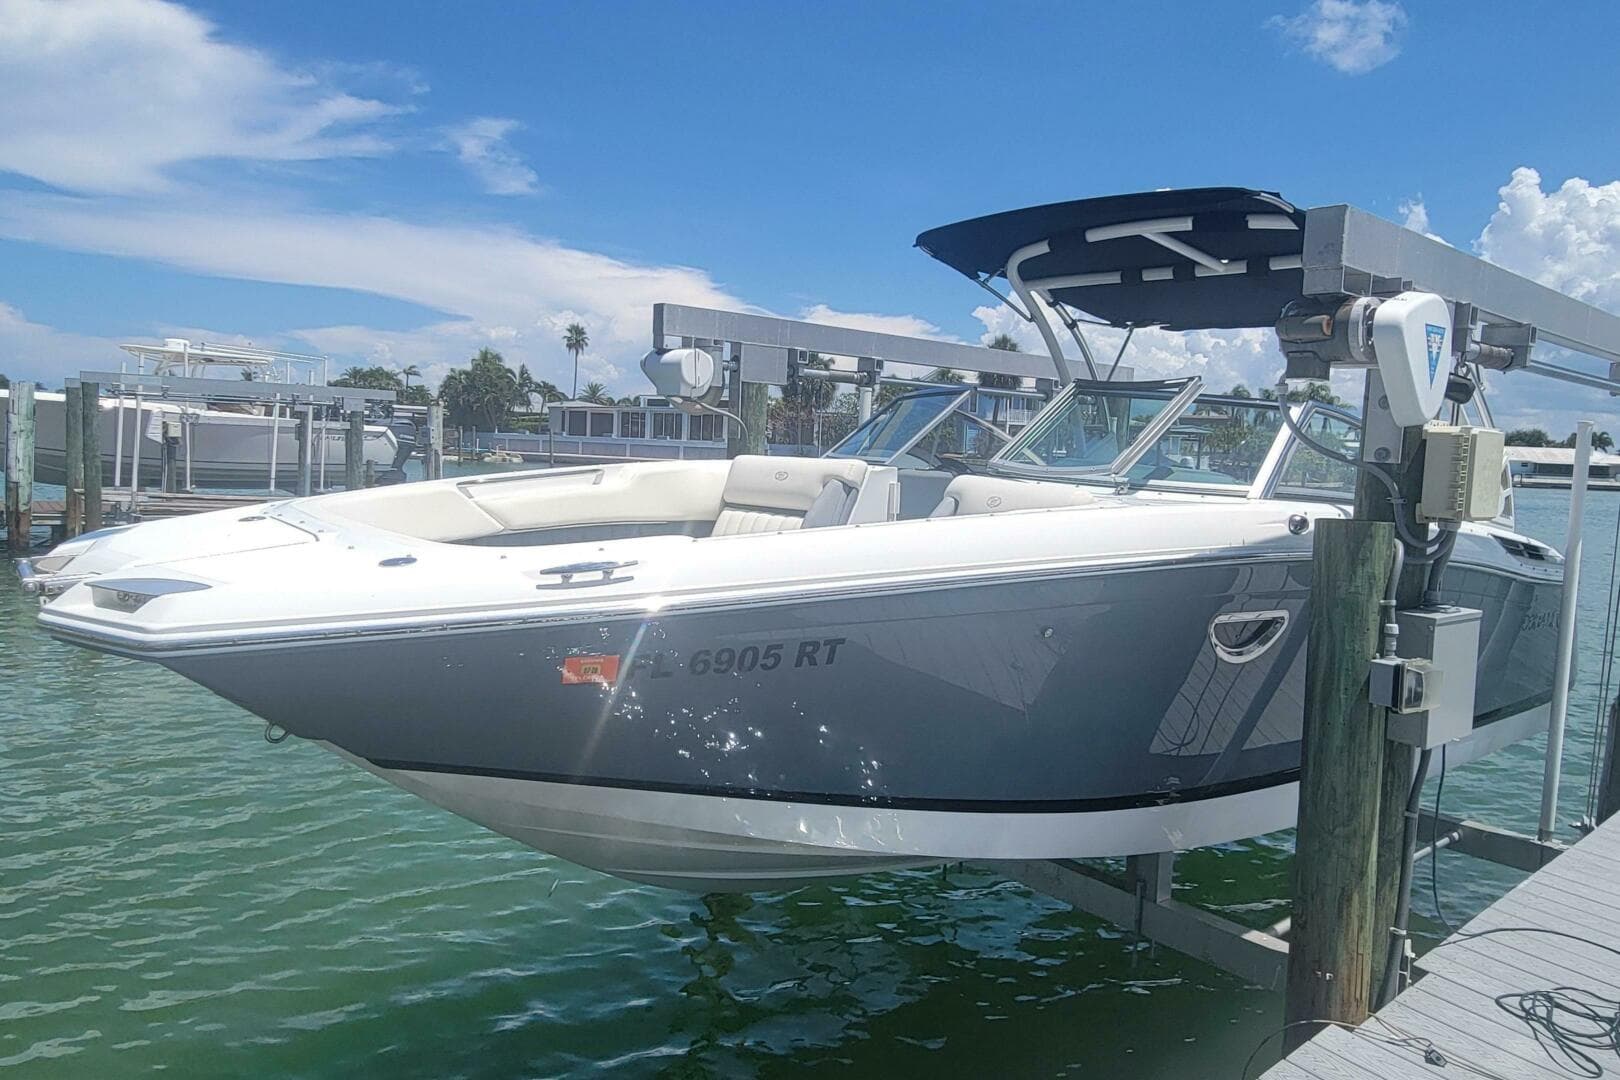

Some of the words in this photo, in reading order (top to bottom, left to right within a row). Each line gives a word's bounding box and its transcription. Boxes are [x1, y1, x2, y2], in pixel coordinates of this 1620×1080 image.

[628, 653, 673, 680] FL
[689, 643, 784, 676] 6905
[794, 637, 846, 669] RT
